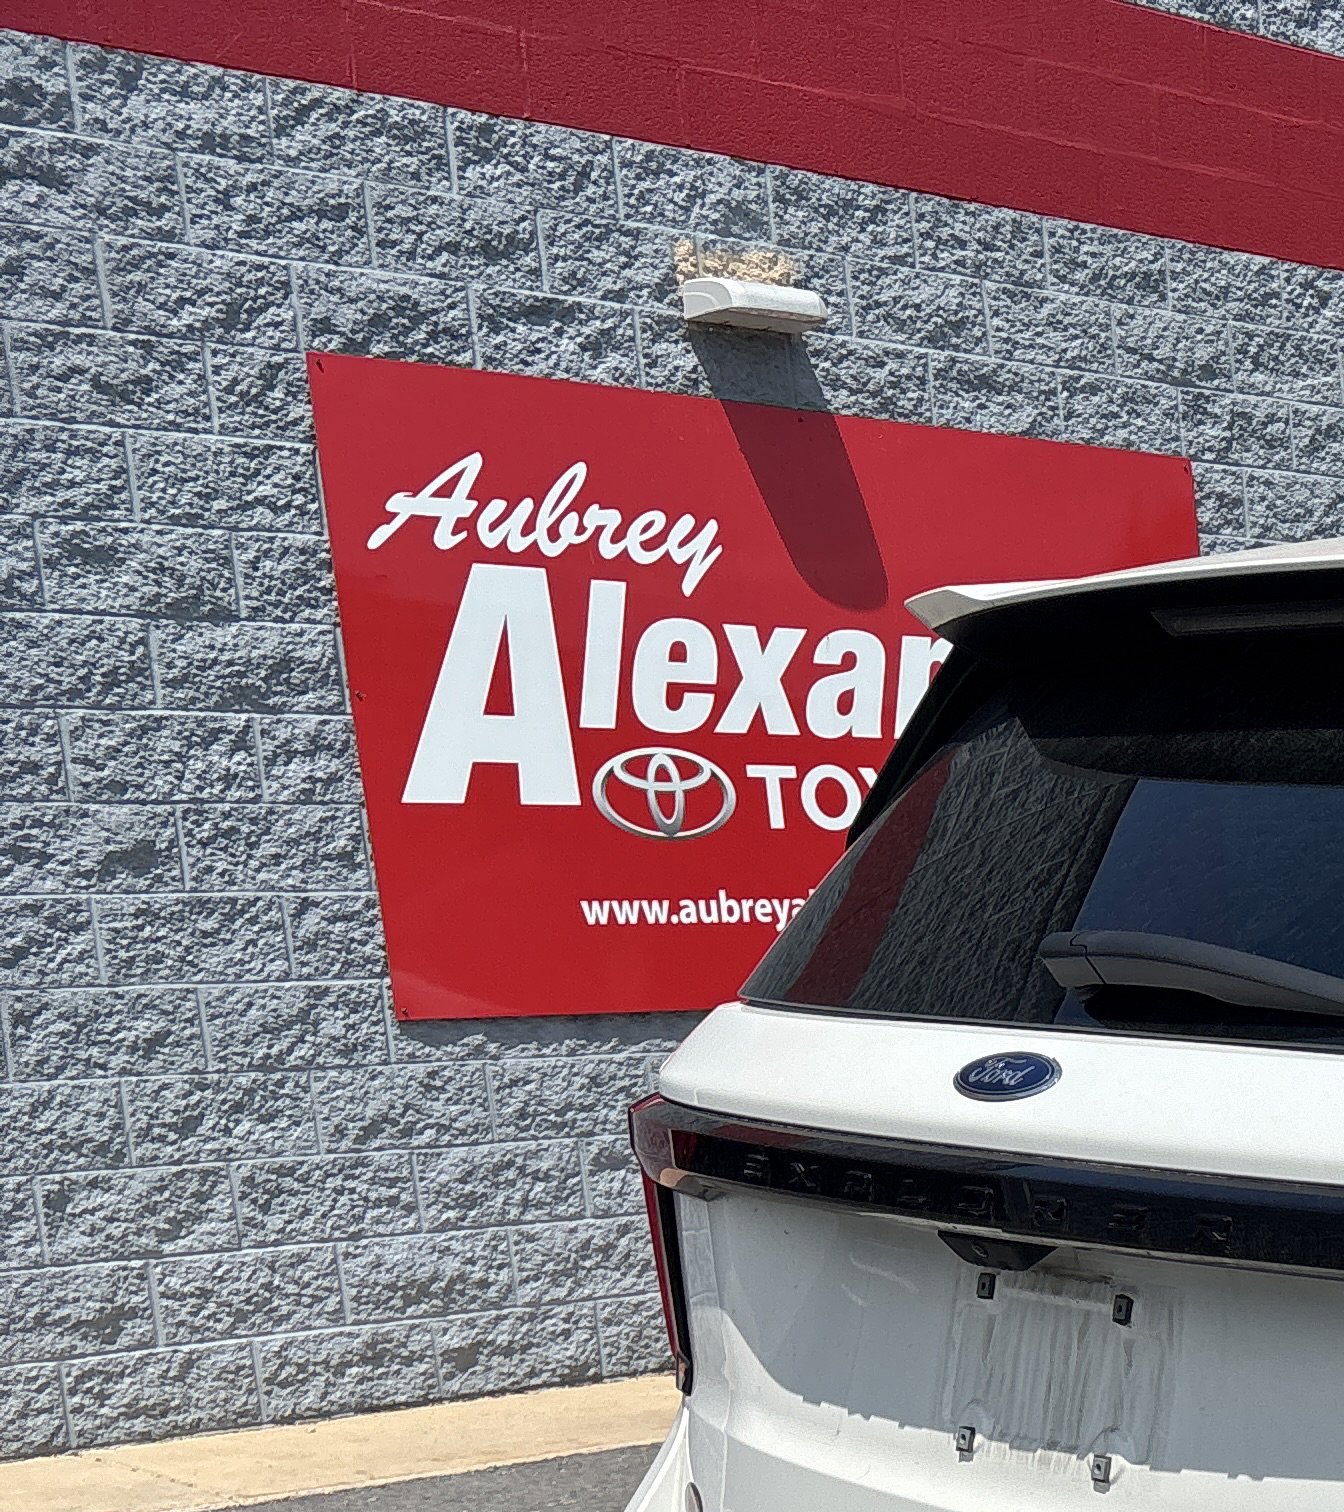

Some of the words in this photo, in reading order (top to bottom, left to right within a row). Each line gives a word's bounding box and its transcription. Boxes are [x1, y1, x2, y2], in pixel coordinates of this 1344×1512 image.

[367, 451, 722, 597] Aubrey
[580, 888, 816, 932] www.aubreya
[968, 1056, 1035, 1085] Ford
